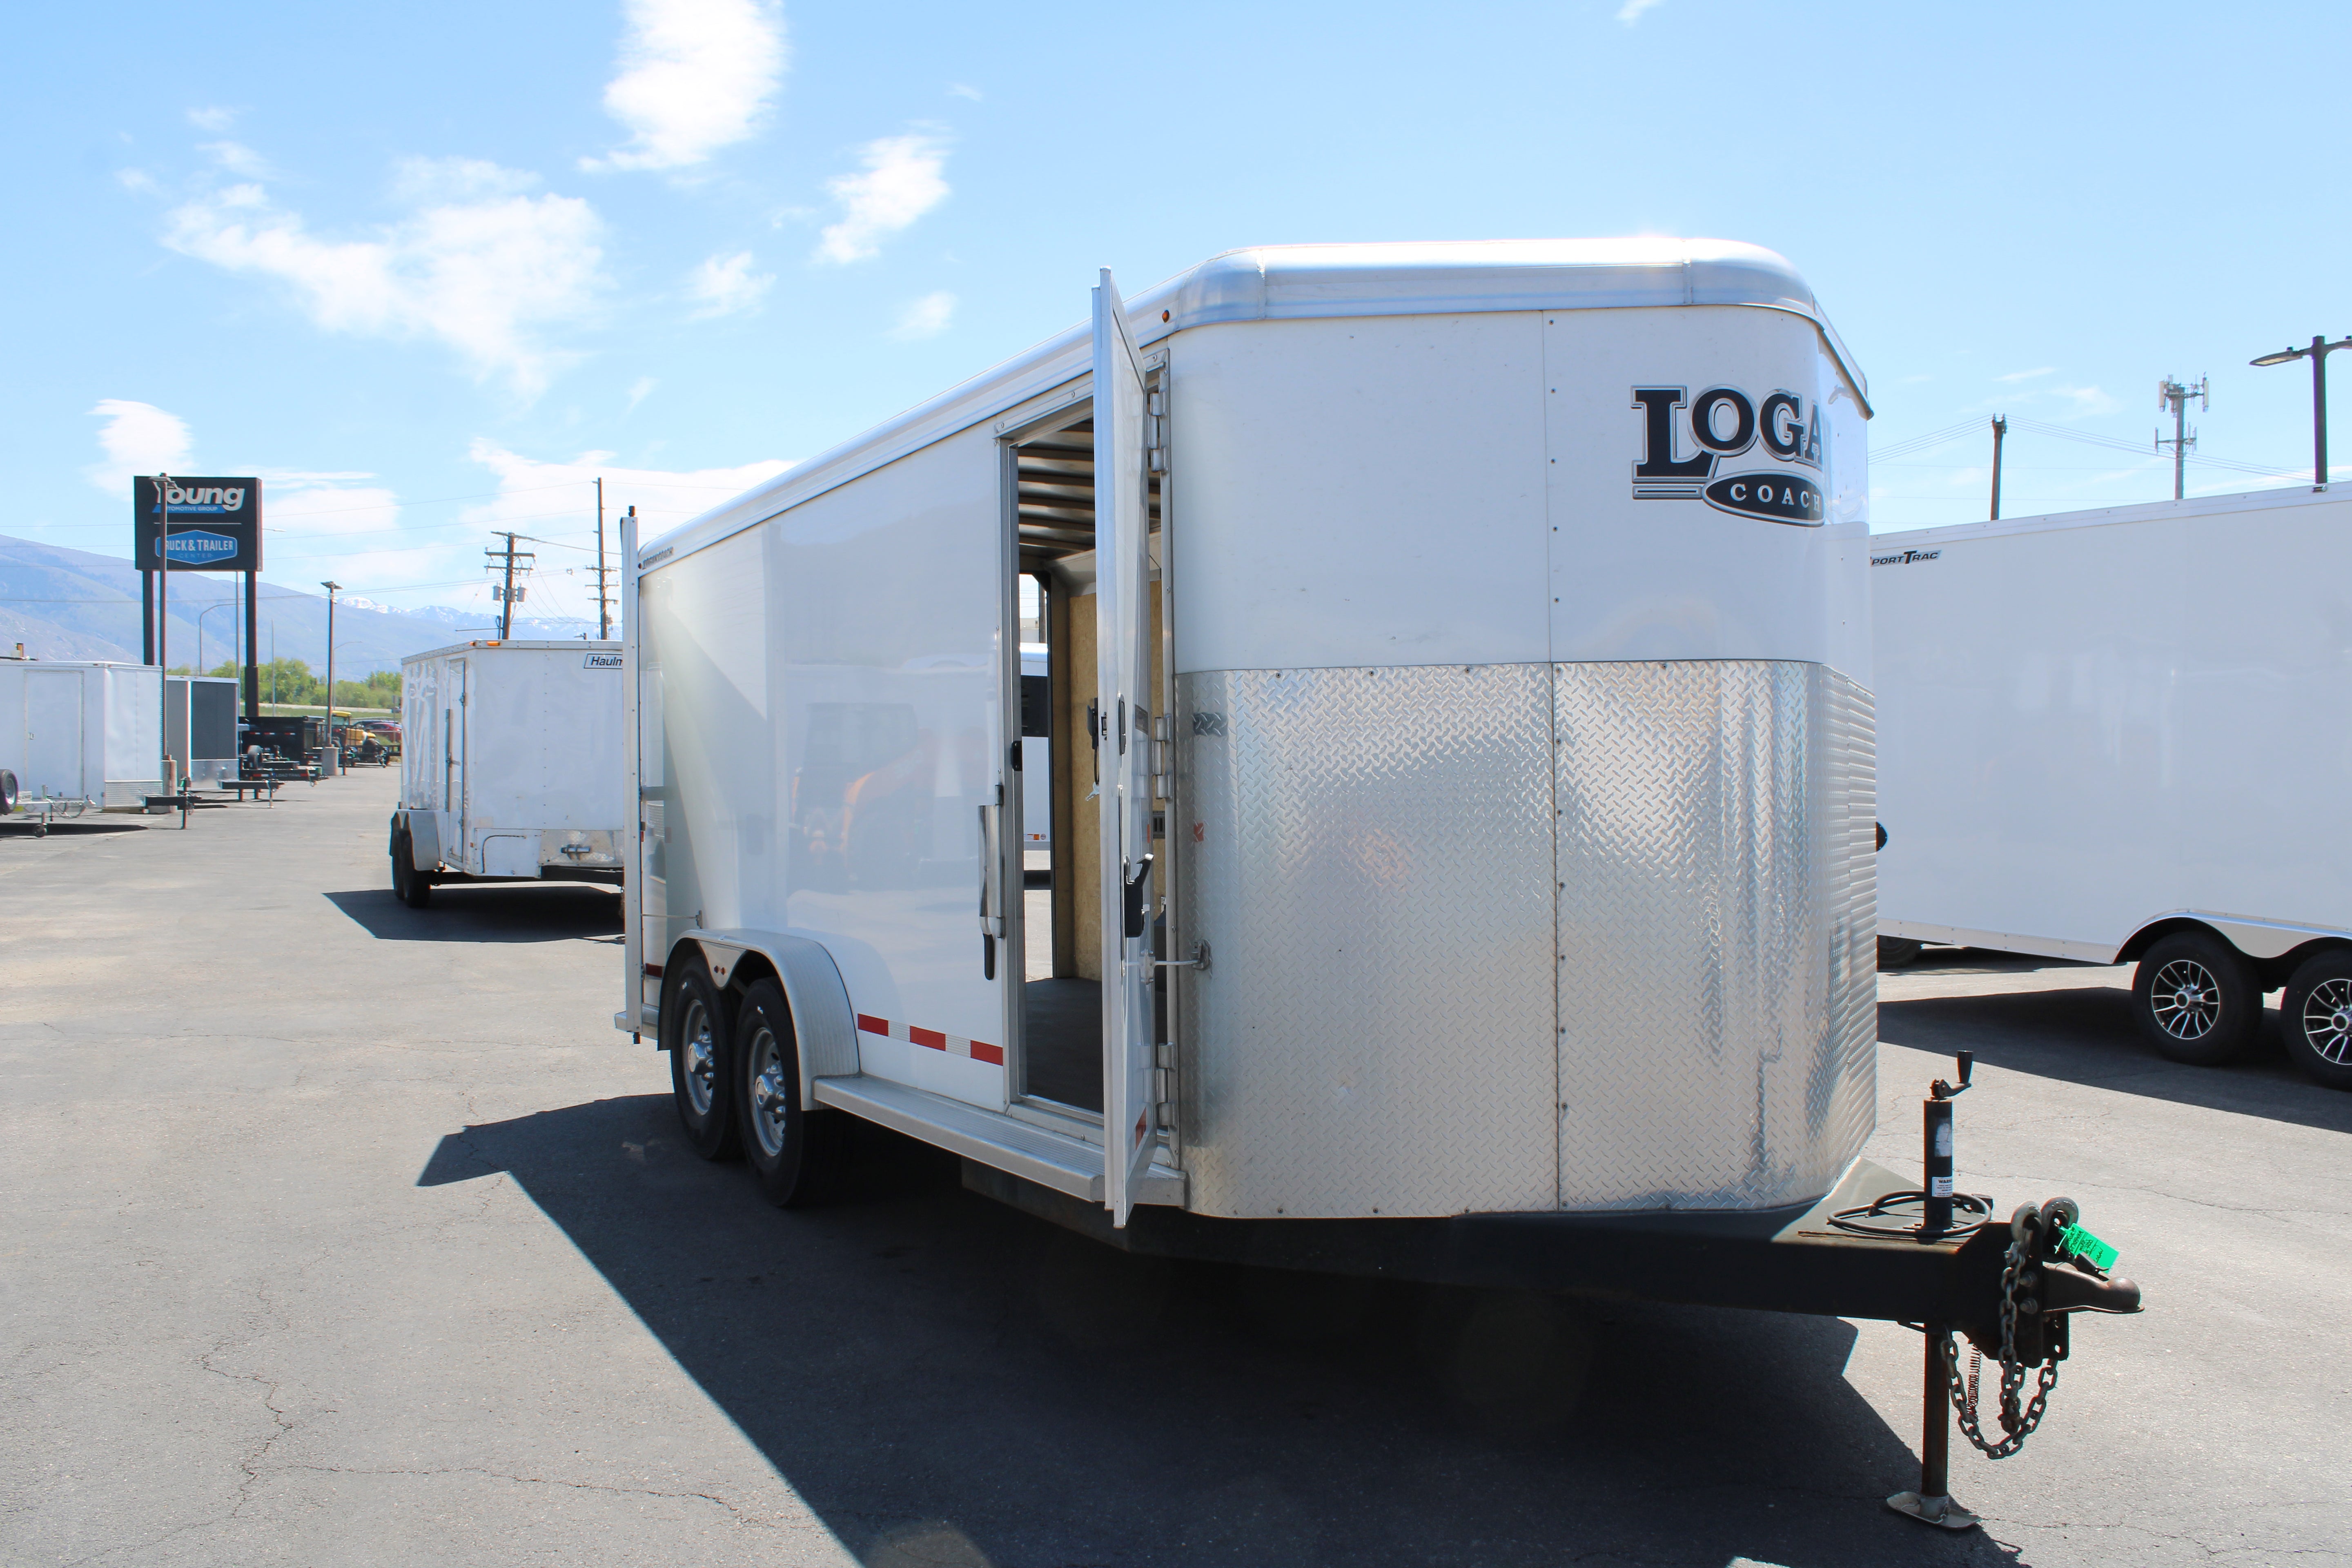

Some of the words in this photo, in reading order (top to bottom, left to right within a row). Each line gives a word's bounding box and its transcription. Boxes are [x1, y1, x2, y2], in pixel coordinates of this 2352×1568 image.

[1631, 384, 1824, 484] LOGA
[1730, 483, 1821, 513] COACH
[166, 540, 187, 551] RUCK
[188, 539, 196, 551] &
[196, 540, 234, 551] TRAILER
[1870, 550, 1938, 566] PORTTRAC
